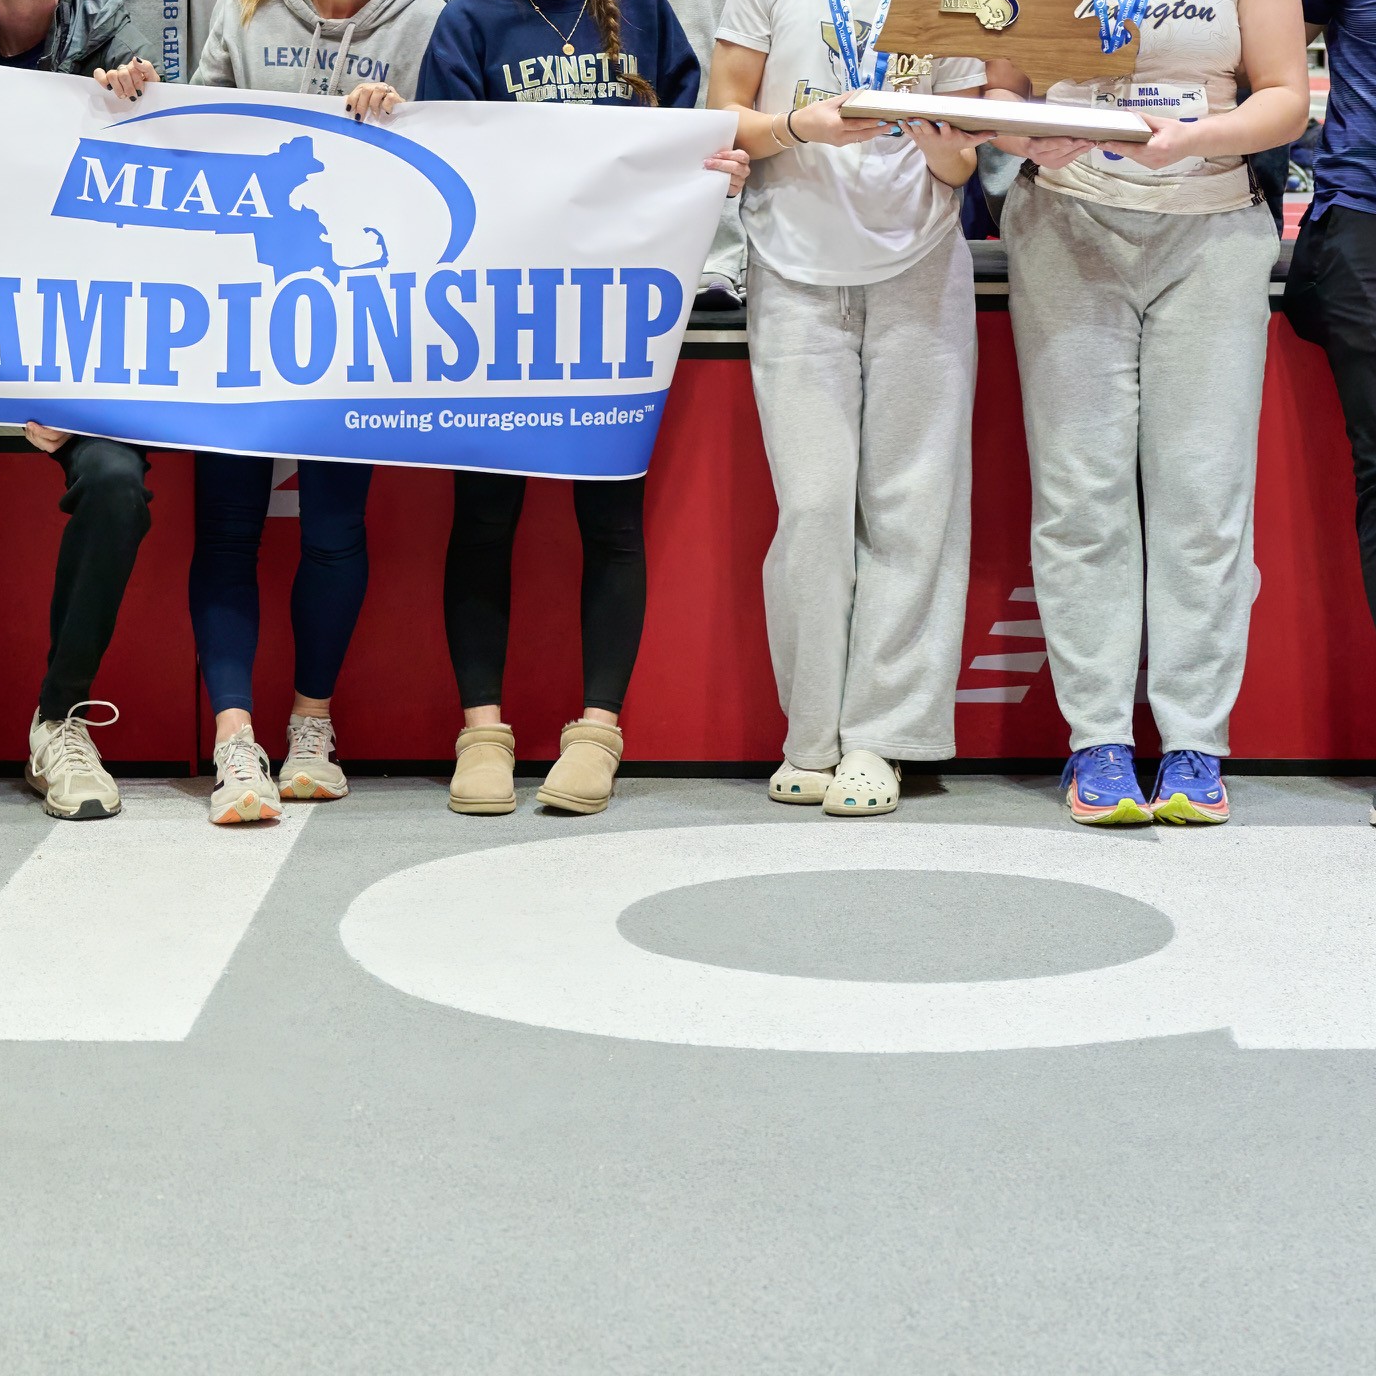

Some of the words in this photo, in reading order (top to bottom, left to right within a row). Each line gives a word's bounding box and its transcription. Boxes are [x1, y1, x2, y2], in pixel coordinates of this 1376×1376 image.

[839, 29, 851, 57] CHAMPION
[264, 47, 390, 83] LEXNTON
[558, 84, 597, 99] TRACK
[597, 84, 606, 98] &
[1117, 97, 1181, 107] Championships
[1138, 88, 1159, 96] MIAA
[77, 156, 274, 218] MIAA
[344, 410, 433, 432] Growing
[438, 409, 564, 431] Courageous
